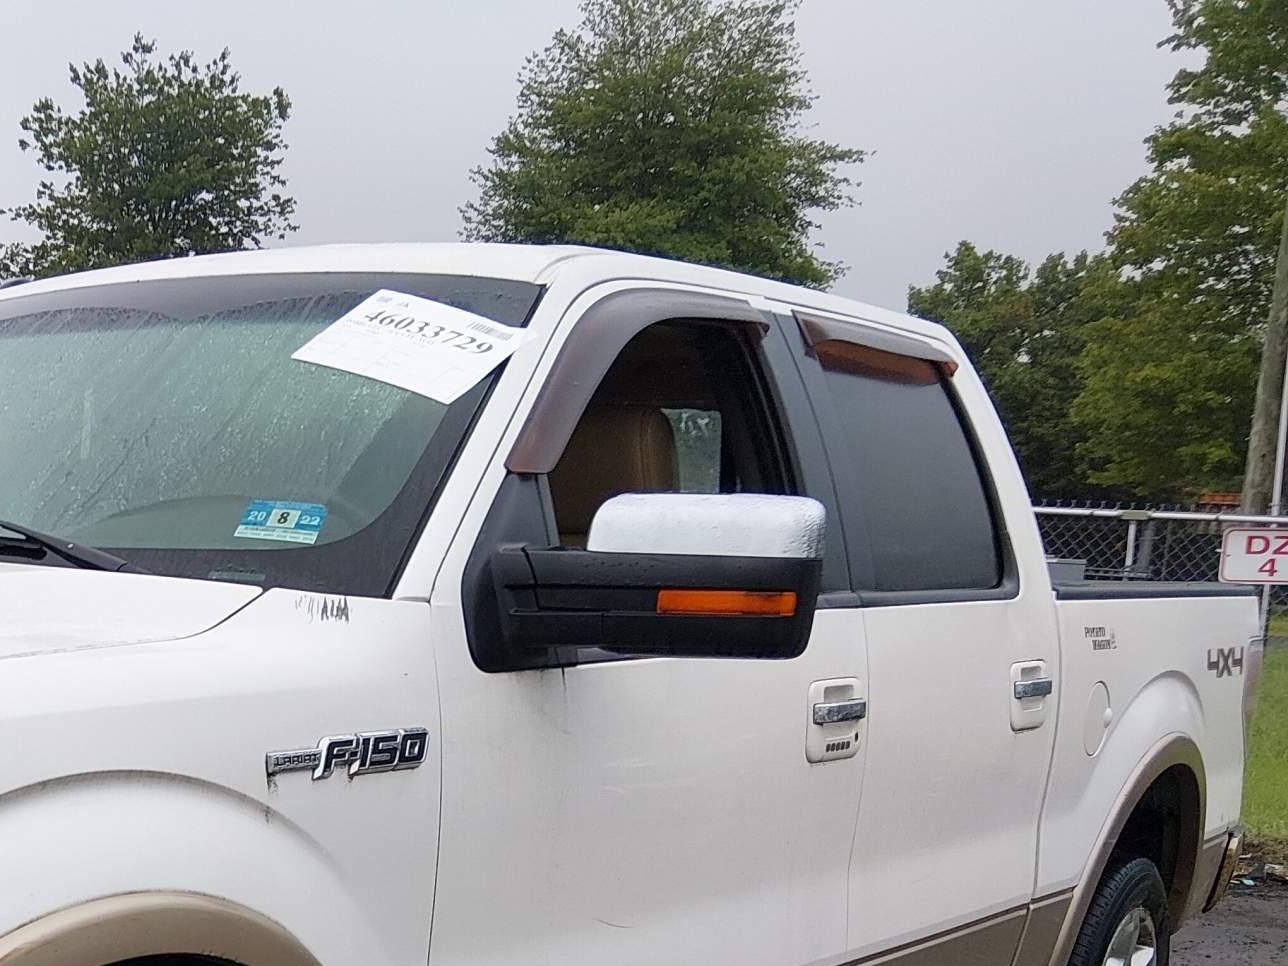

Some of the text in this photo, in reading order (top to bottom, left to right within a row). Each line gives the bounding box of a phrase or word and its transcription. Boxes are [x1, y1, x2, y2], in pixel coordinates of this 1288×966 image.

[364, 310, 494, 354] 46033729
[248, 510, 321, 526] 20 8 22
[1257, 558, 1278, 577] 4
[312, 727, 430, 781] F-150
